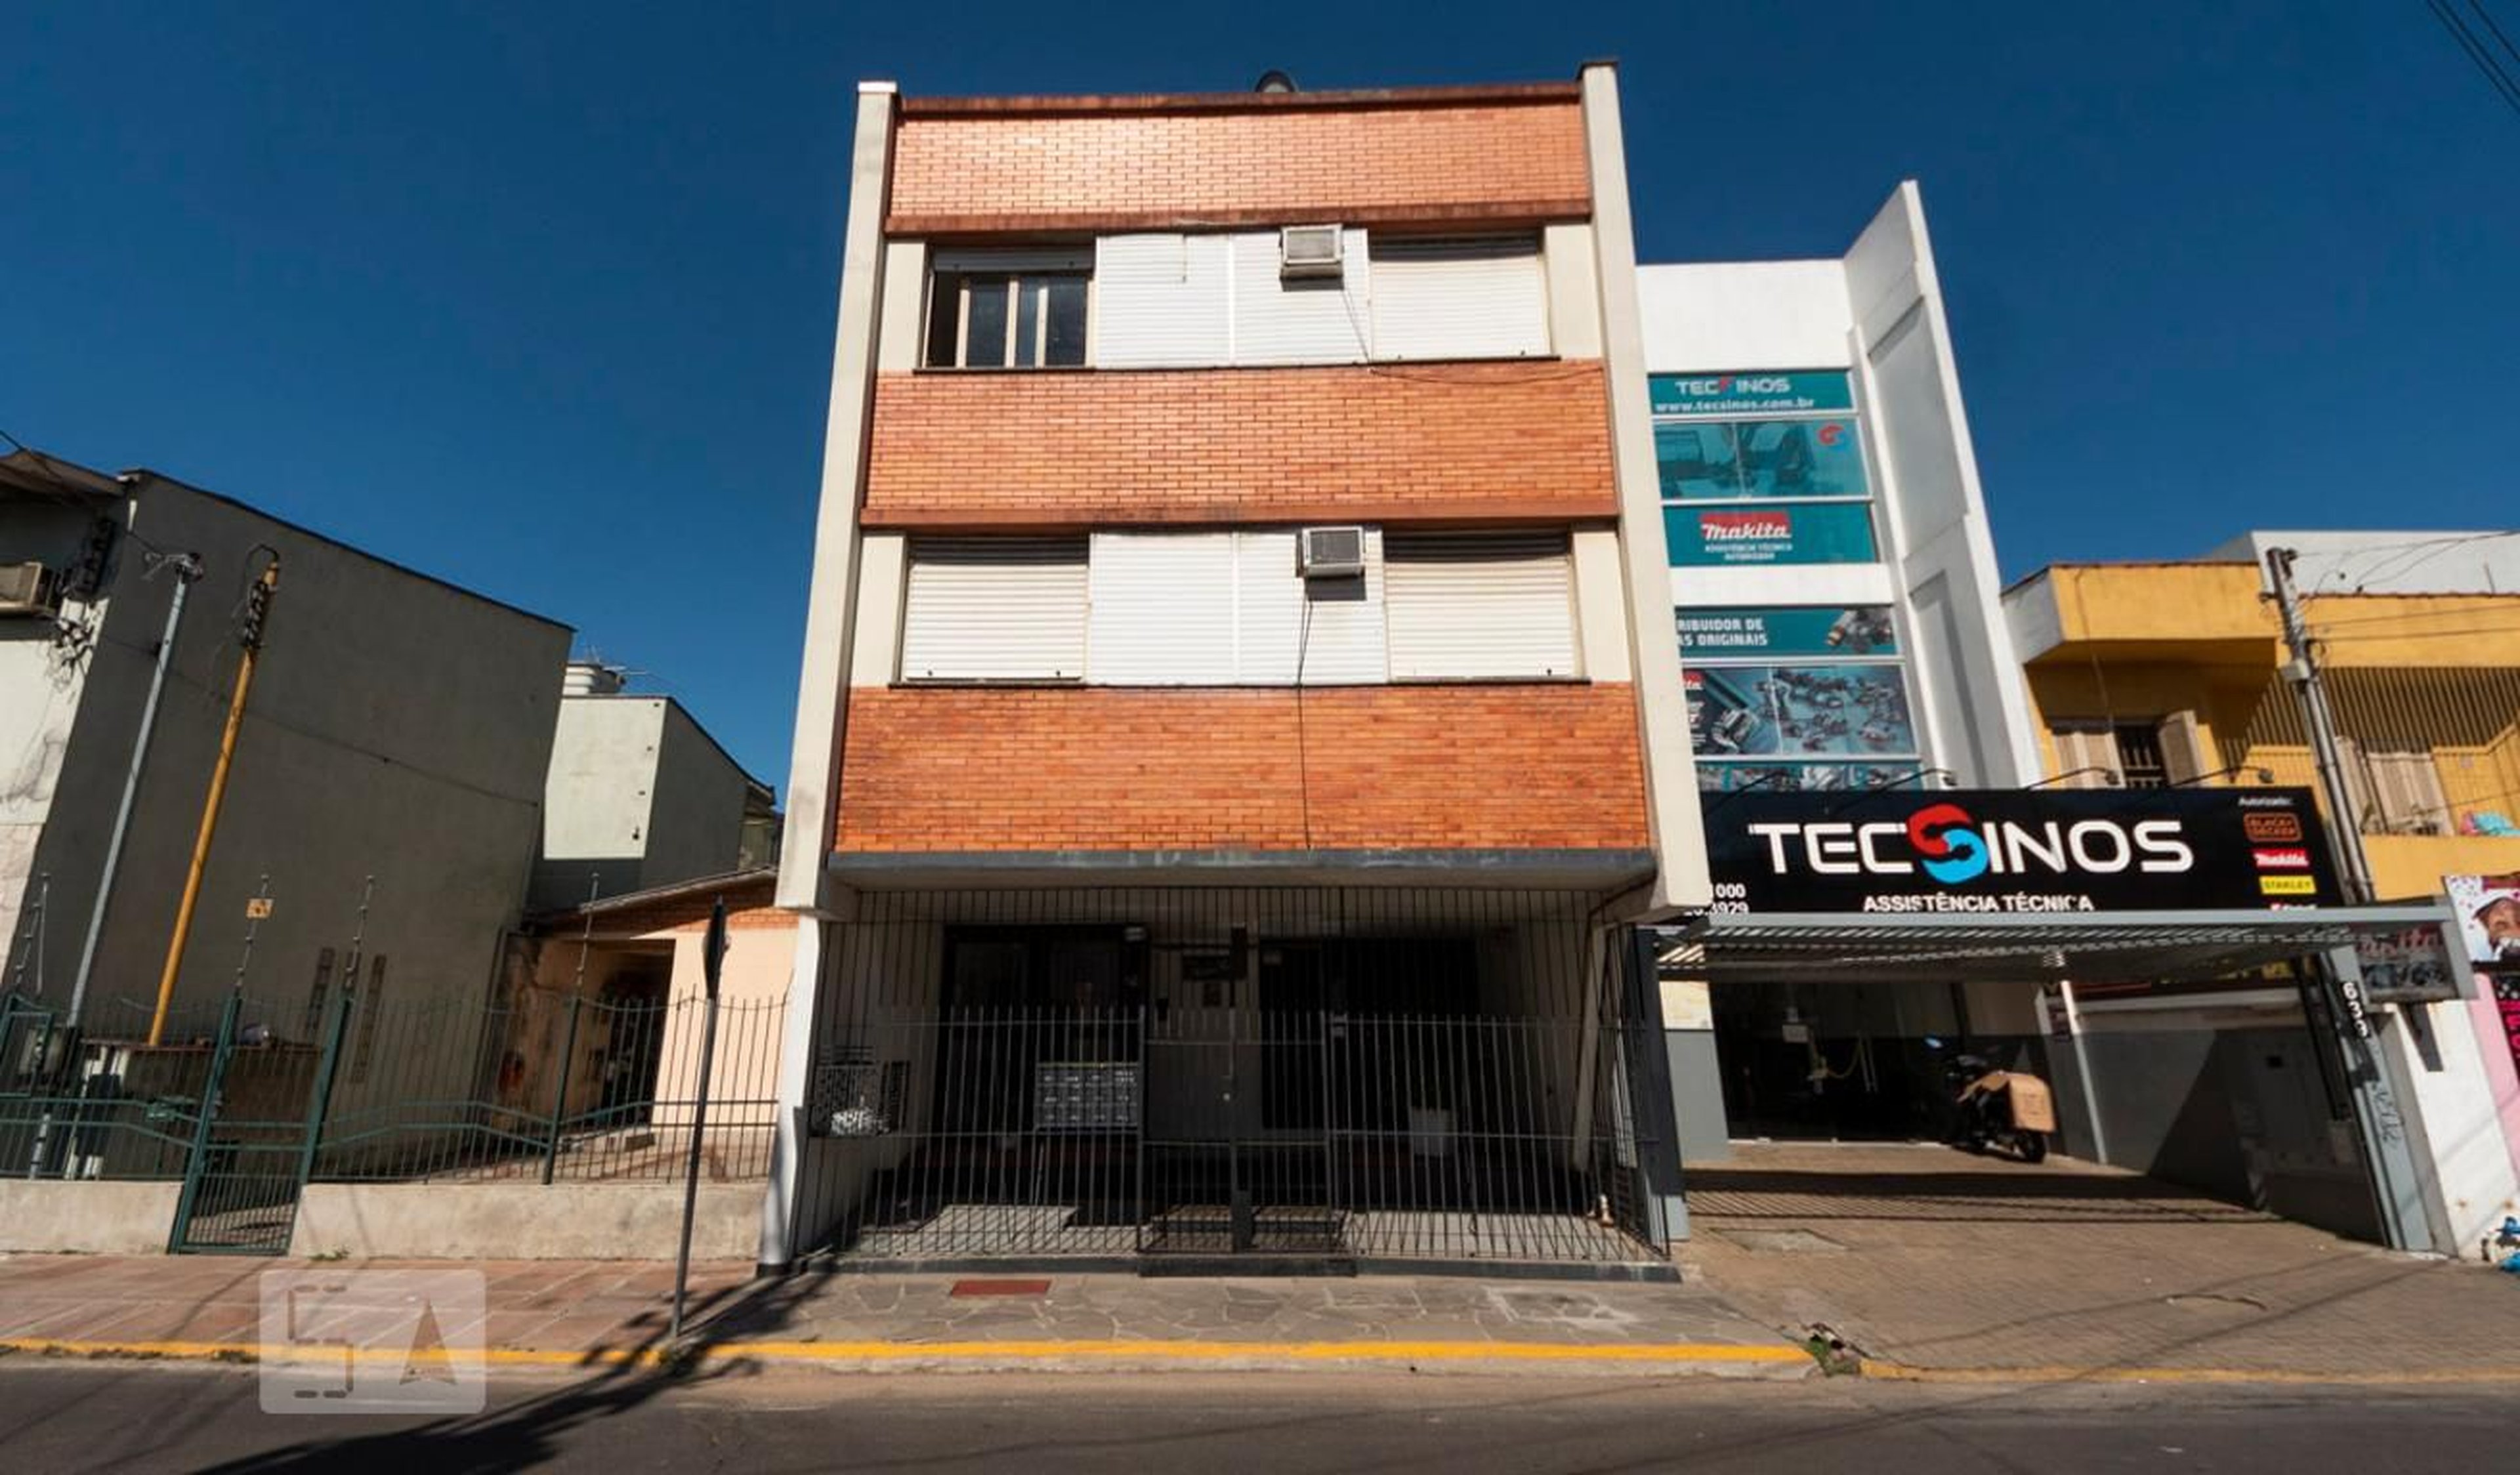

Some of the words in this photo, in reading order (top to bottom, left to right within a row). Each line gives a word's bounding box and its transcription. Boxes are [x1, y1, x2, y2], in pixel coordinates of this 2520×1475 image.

[1655, 396, 1815, 413] www.tecsinos.com.br
[1745, 617, 1765, 631] DE
[1697, 633, 1769, 646] ORIGINAIS
[1748, 802, 2194, 884] TECSINOS
[1863, 892, 1999, 913] ASSISTÊNCIA
[2003, 893, 2095, 911] TÉCNICA
